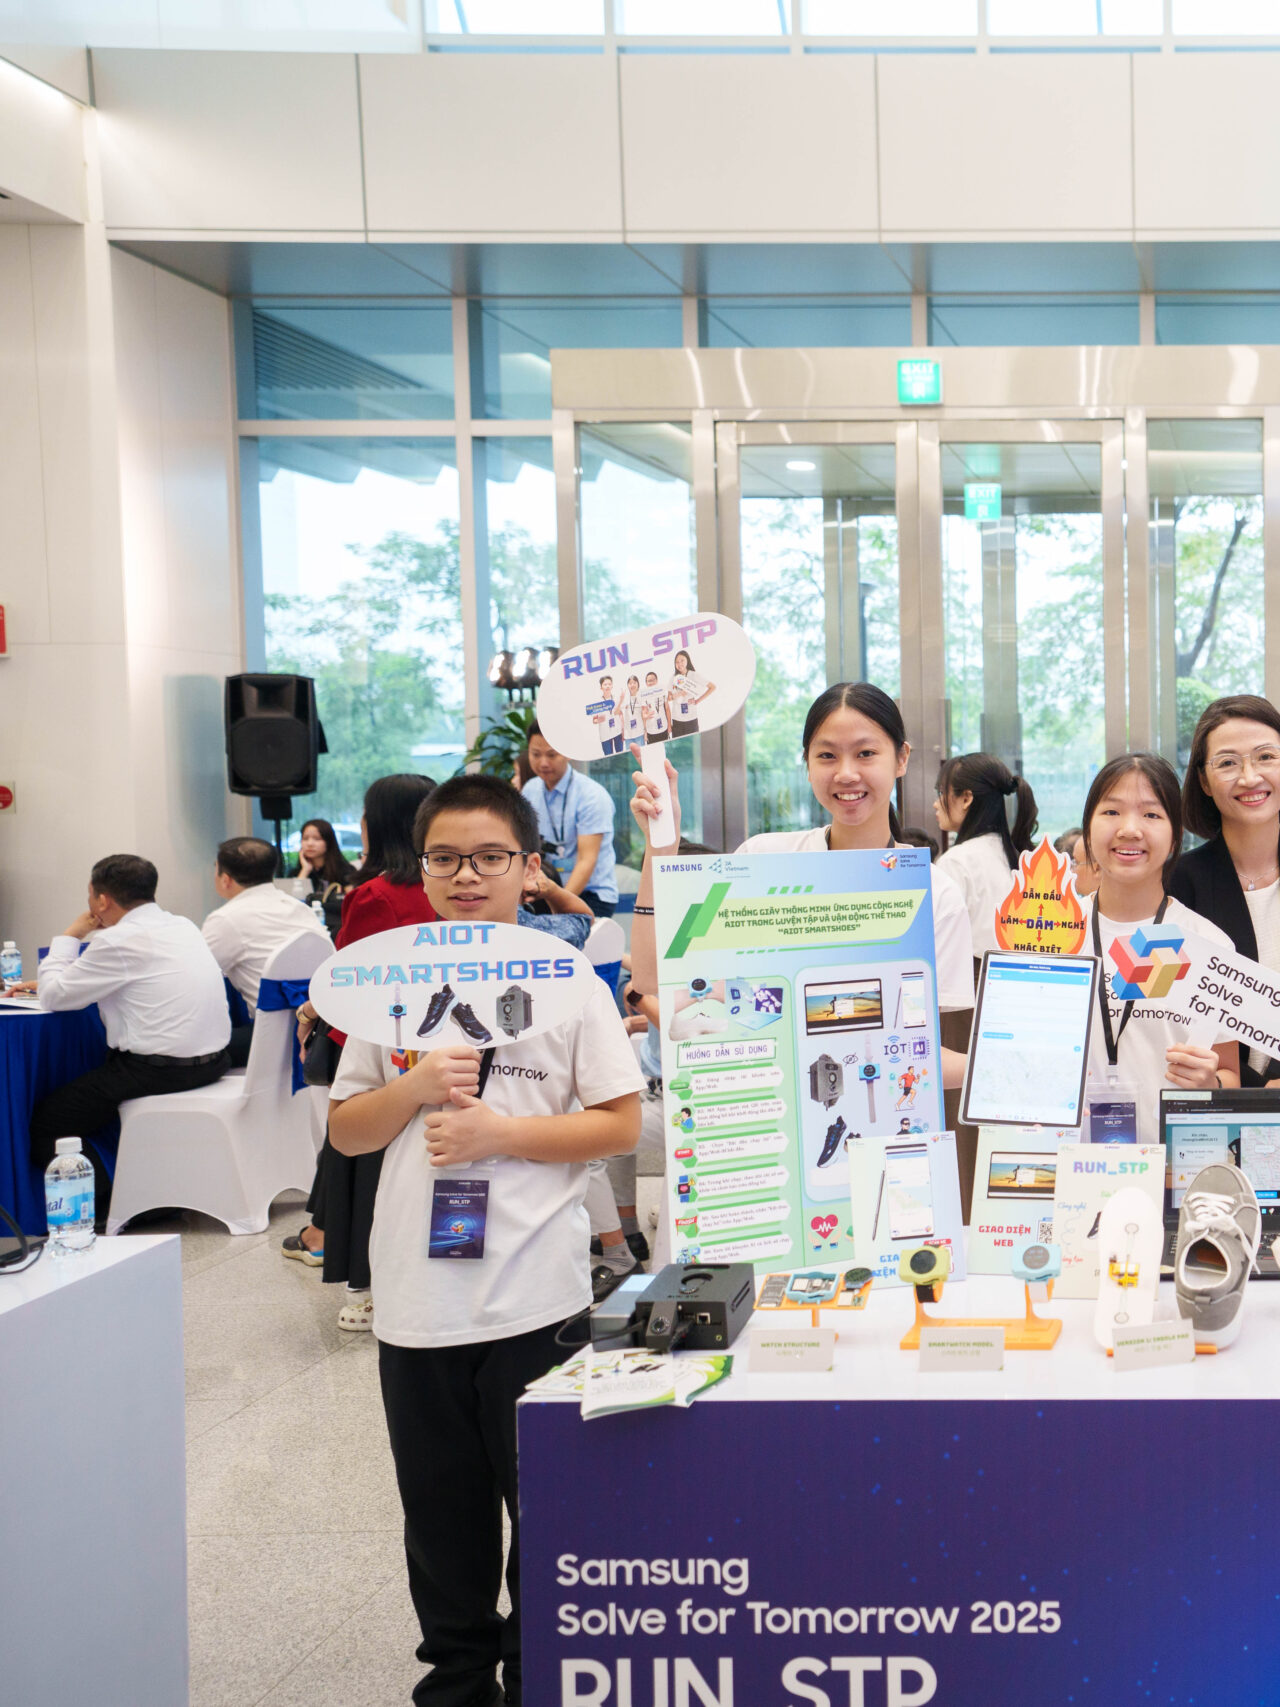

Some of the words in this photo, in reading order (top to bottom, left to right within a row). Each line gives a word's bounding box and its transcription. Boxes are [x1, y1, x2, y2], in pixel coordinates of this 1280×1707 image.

[901, 363, 935, 374] EXIT
[560, 619, 718, 680] RUN_STP
[660, 863, 703, 873] SAMSUNG
[718, 909, 730, 918] HỆ
[809, 905, 831, 913] MINH
[851, 903, 871, 913] DỤNG
[893, 899, 914, 909] NGHỆ
[724, 920, 745, 928] AIOT
[747, 919, 775, 927] TRONG
[886, 911, 907, 919] THAO
[413, 923, 496, 947] AIOT
[330, 958, 575, 988] SMARTSHOES
[1197, 975, 1244, 1008] Solve
[1108, 1008, 1122, 1018] or
[1188, 995, 1214, 1018] for
[884, 1043, 907, 1056] IOT
[914, 1043, 924, 1053] AI
[490, 1064, 549, 1081] morrow
[1073, 1161, 1150, 1175] RUN_STP
[978, 1225, 1004, 1234] GIAO
[1006, 1223, 1031, 1236] DIỆN
[993, 1238, 1014, 1248] WEB
[880, 1254, 900, 1263] GIA
[555, 1554, 750, 1595] Samsung
[556, 1602, 667, 1636] Solve
[676, 1599, 736, 1635] for
[746, 1601, 960, 1635] Tomorrow
[970, 1601, 1062, 1634] 2025
